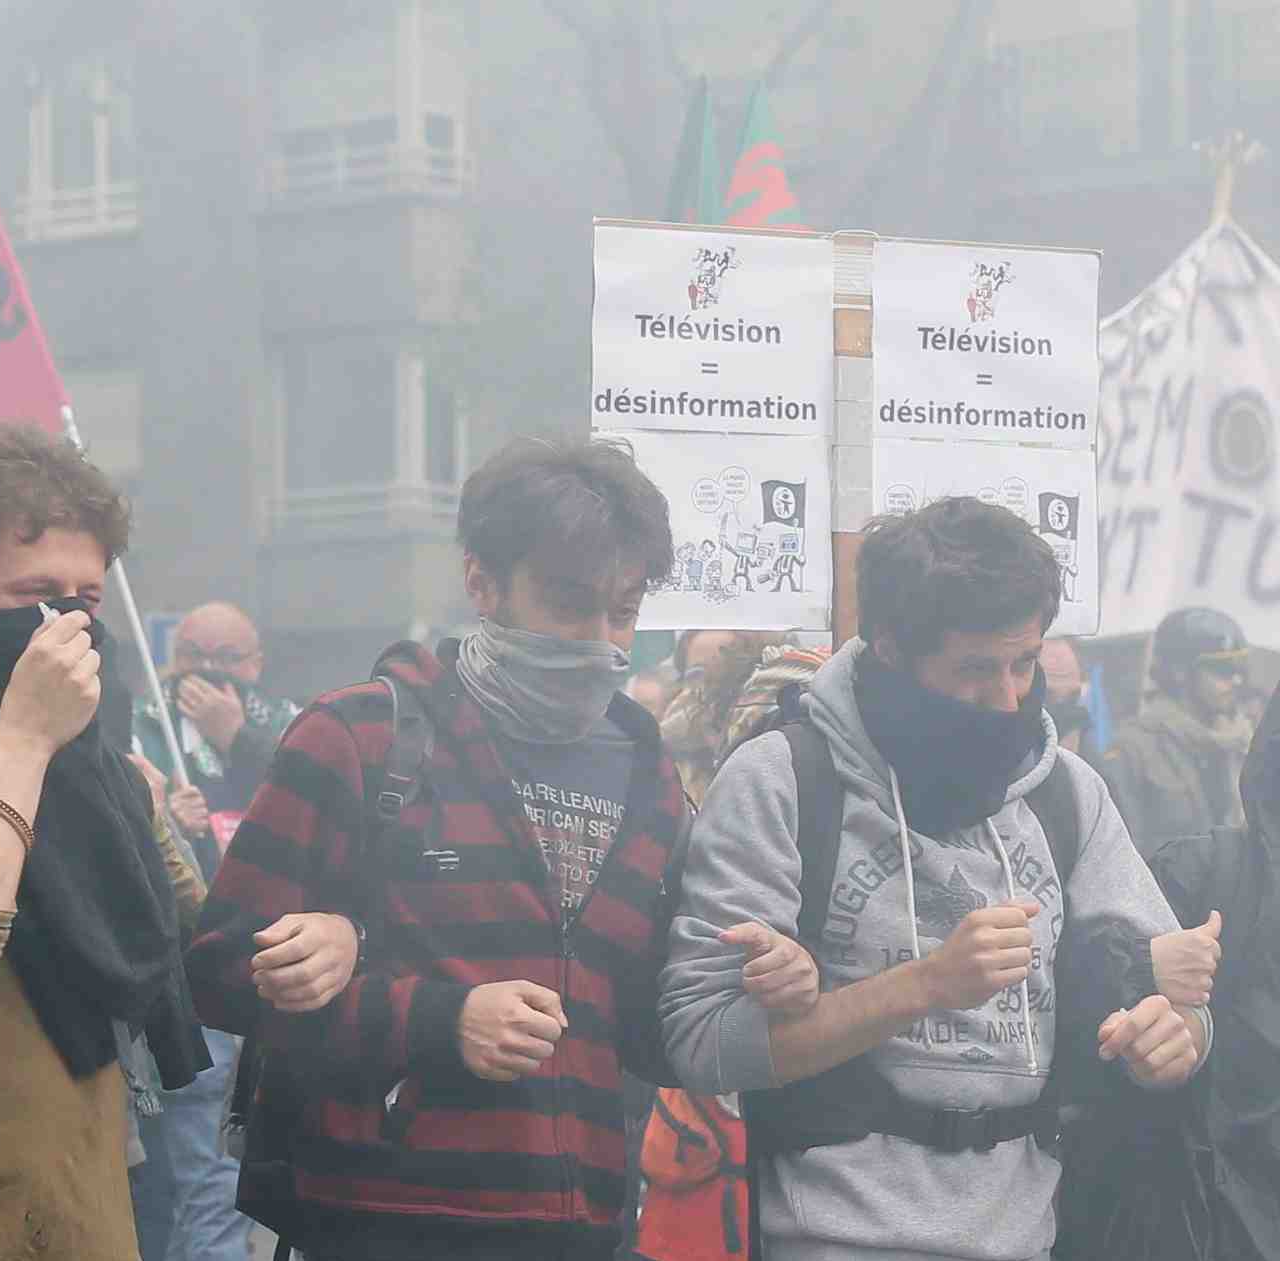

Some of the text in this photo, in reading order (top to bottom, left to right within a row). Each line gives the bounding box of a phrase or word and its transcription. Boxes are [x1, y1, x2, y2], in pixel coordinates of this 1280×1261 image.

[634, 313, 782, 345] Télévision
[917, 326, 1053, 357] Télévision
[700, 362, 719, 375] =
[976, 373, 993, 386] =
[593, 389, 818, 422] désinformation
[878, 399, 1087, 431] désinformation
[524, 803, 585, 832] ERICAN
